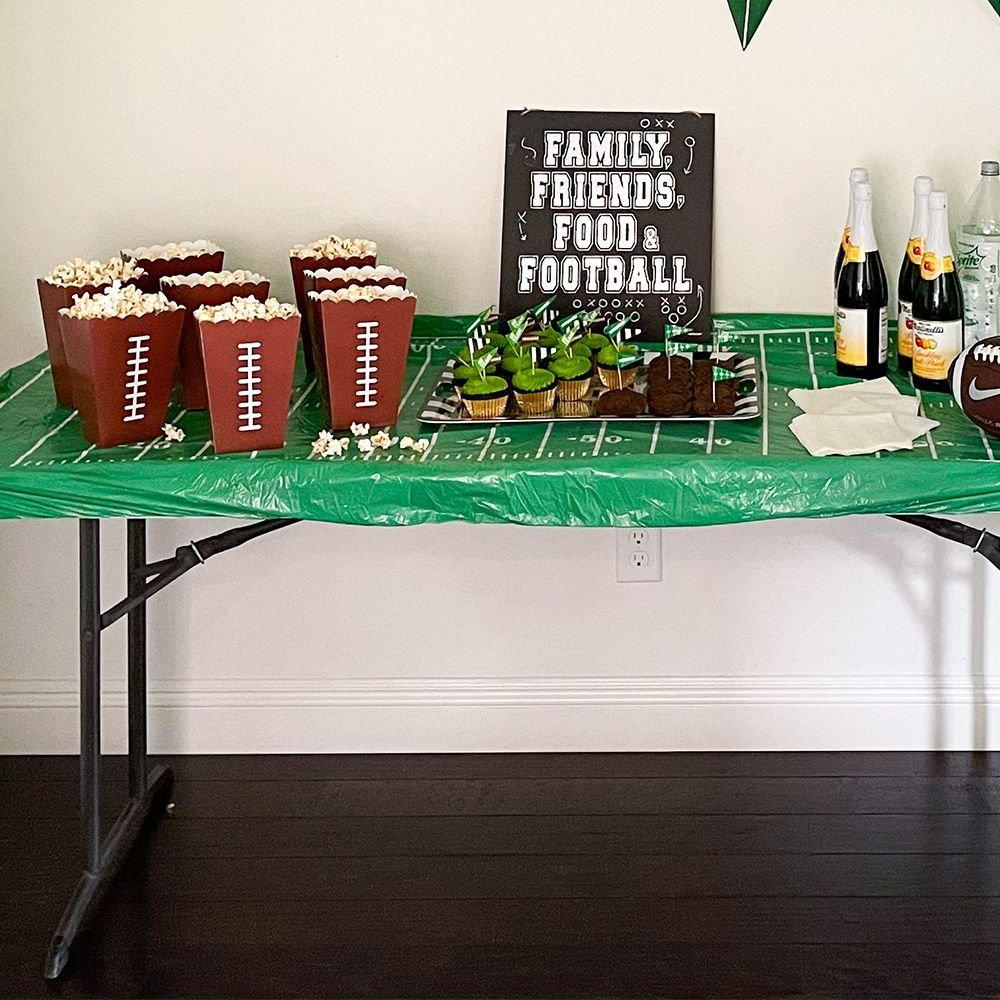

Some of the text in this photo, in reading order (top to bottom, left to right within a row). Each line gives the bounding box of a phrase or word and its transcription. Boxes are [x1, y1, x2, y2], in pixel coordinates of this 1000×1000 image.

[541, 130, 673, 170] FAMILY,
[529, 171, 686, 210] FRIENDS,
[552, 213, 660, 251] FOOD &
[517, 255, 693, 294] FOOTBALL
